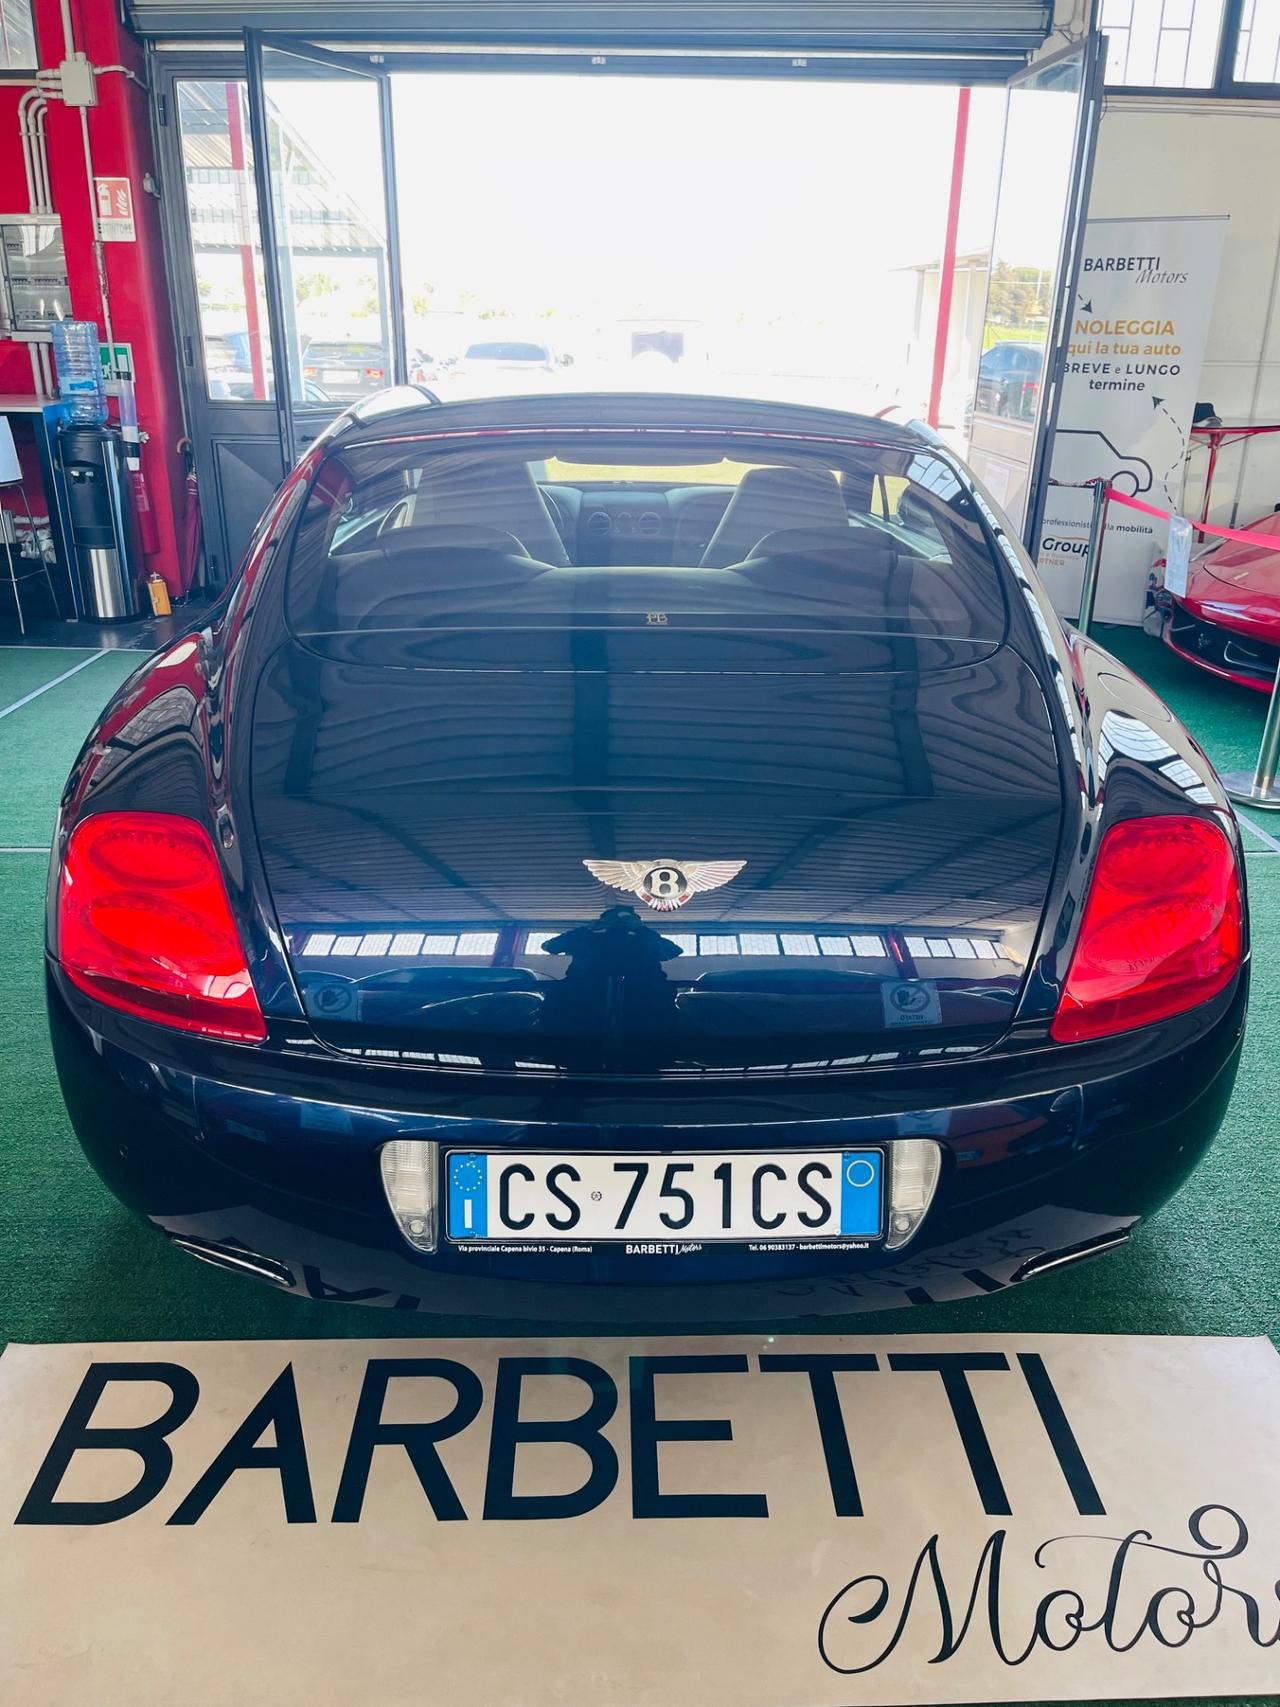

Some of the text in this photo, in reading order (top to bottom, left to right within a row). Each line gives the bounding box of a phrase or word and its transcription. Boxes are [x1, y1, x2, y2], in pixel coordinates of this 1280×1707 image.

[1083, 257, 1160, 272] BARBETTI
[1135, 268, 1189, 284] Motors
[1075, 320, 1175, 335] NOLEGGIA
[1067, 341, 1181, 357] qui la tua auto
[1064, 362, 1181, 376] BREVE e LUNGO
[1089, 378, 1146, 391] termine
[499, 1162, 833, 1231] CS 751CS
[500, 1245, 522, 1253] Capena
[549, 1246, 572, 1254] Capena
[572, 1246, 593, 1254] (Roma)
[625, 1244, 679, 1255] BARBETTI
[799, 1242, 870, 1252] barbettimotors@yahoo.it
[13, 1353, 1107, 1525] BARBETTI
[818, 1504, 1280, 1675] Motor
